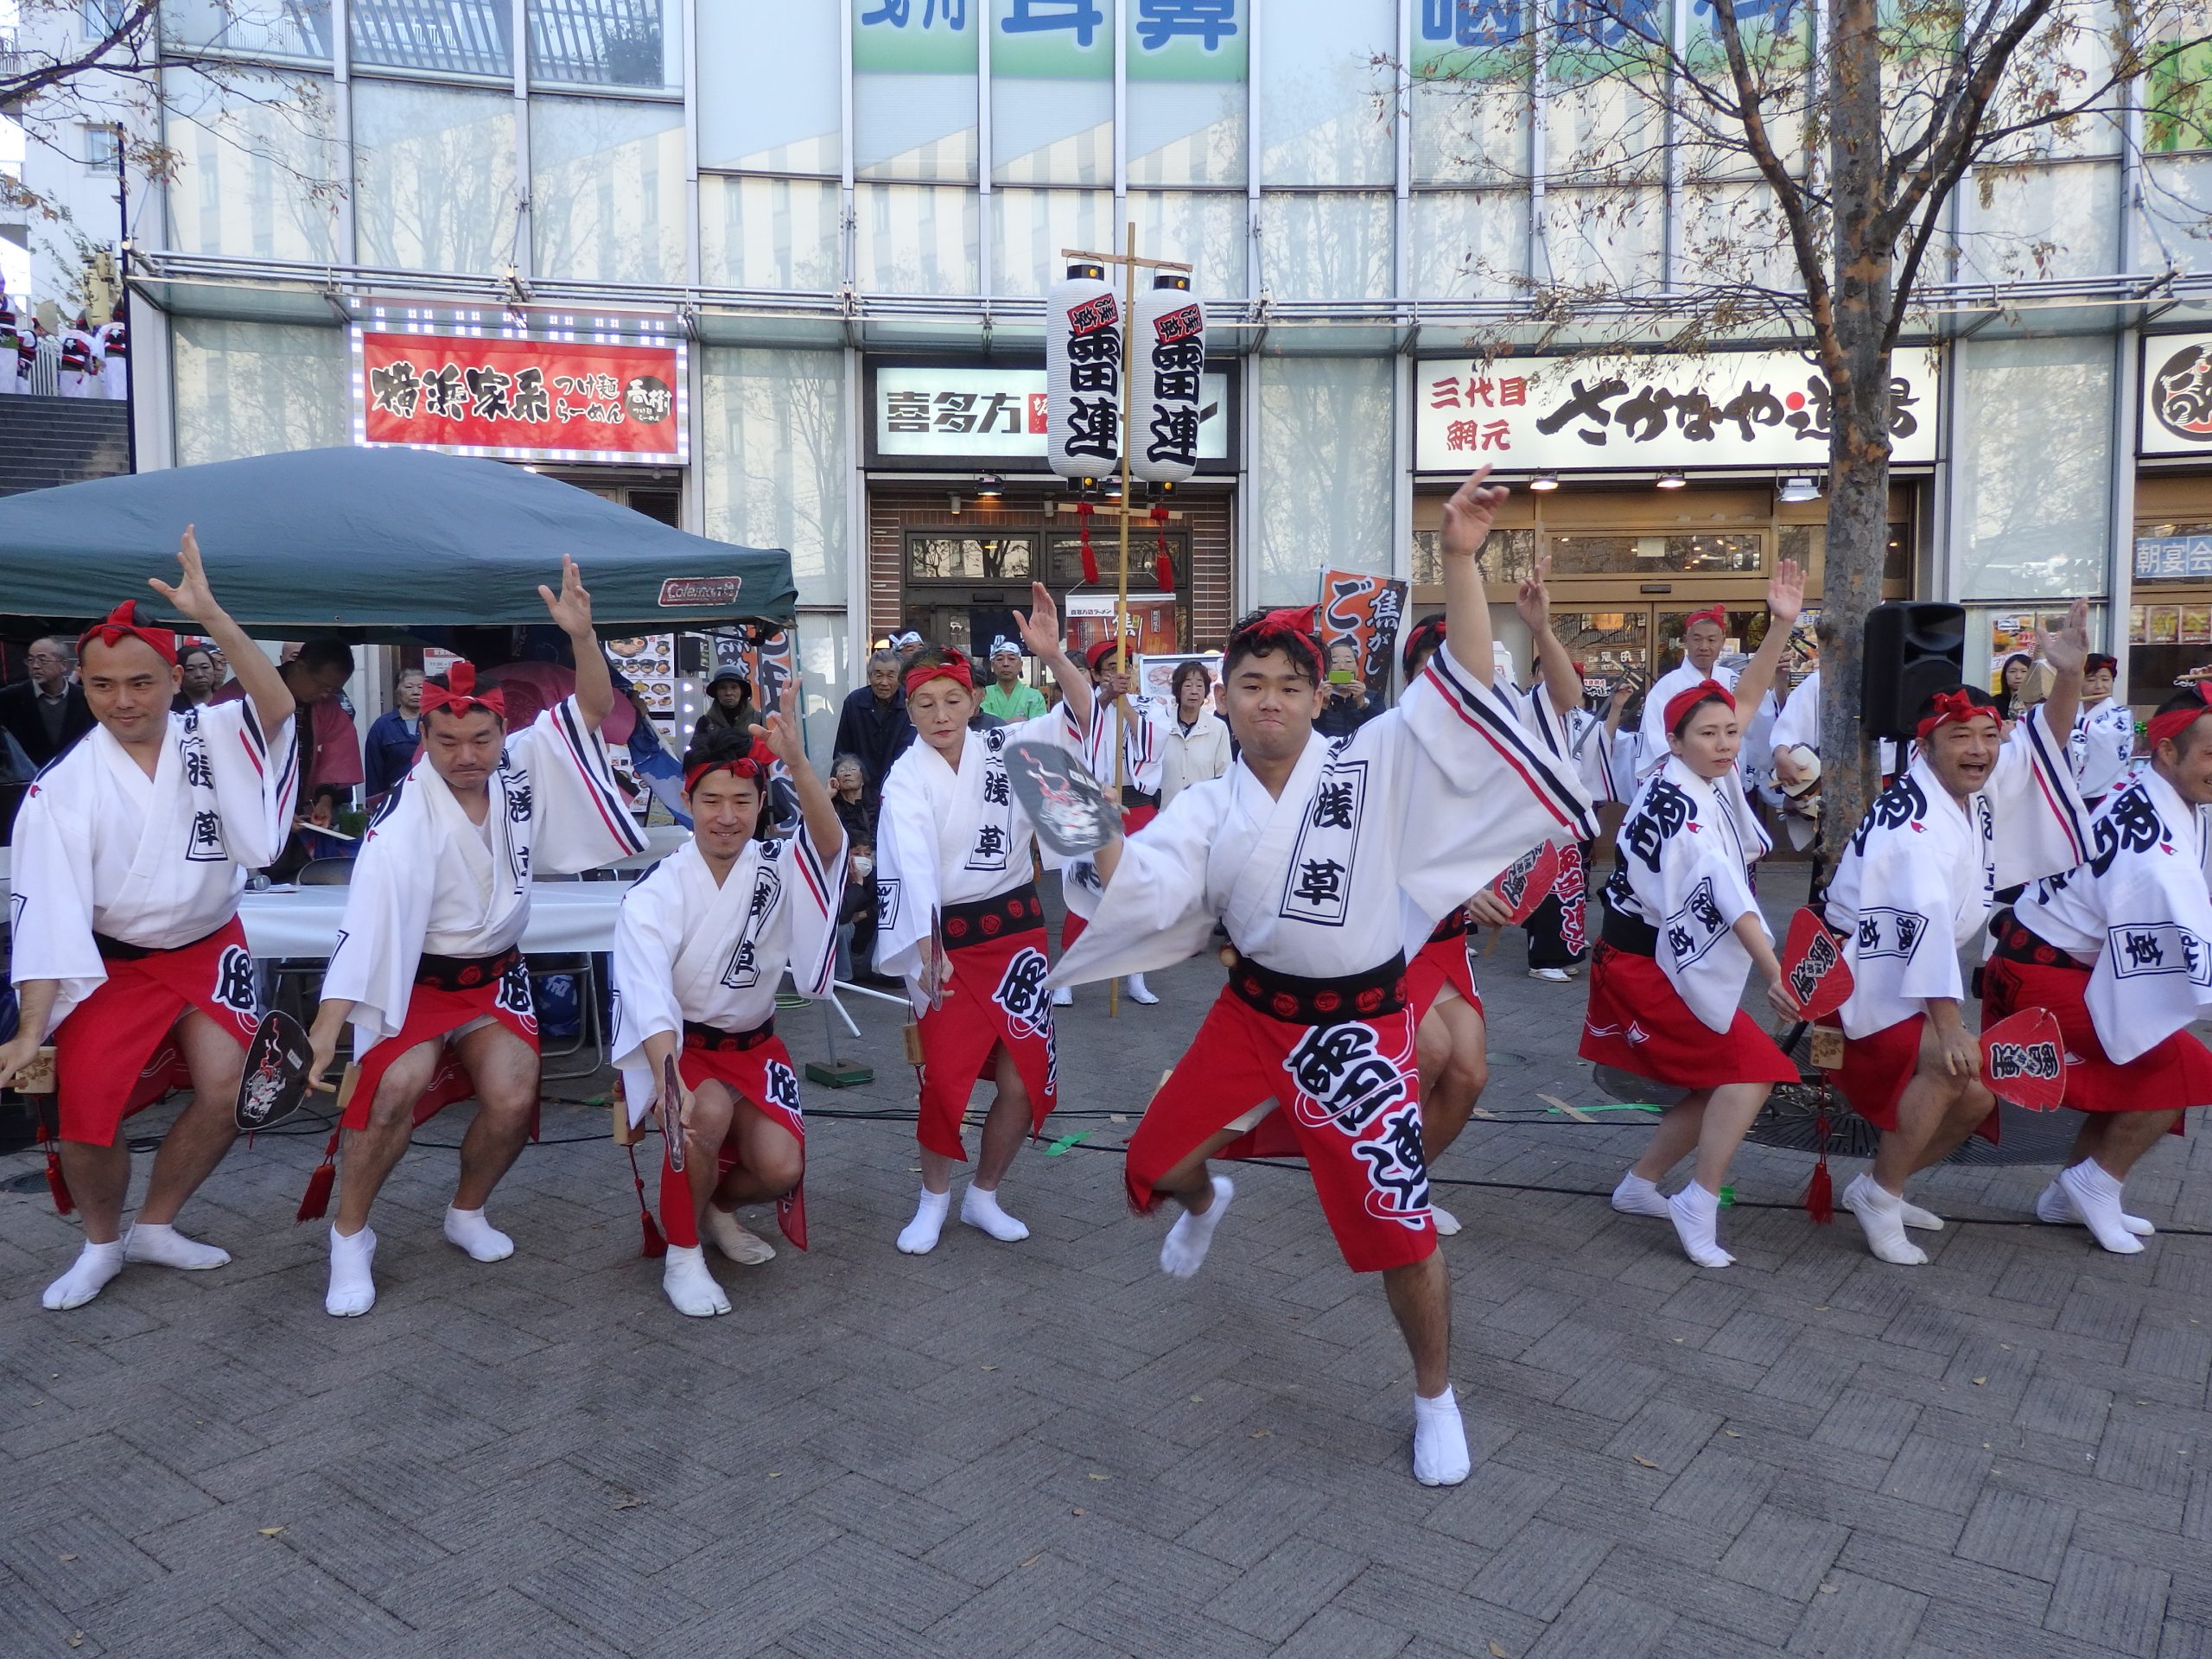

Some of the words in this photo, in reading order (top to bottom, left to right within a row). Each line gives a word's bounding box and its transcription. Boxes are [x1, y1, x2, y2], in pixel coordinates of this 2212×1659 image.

[371, 361, 550, 423] 横浜家系
[553, 373, 620, 399] つけ麺
[1430, 376, 1528, 409] 三代目
[556, 398, 625, 423] らーめん
[887, 391, 1020, 433] 喜多方
[1446, 420, 1511, 450] 網元
[1365, 589, 1401, 675] 焦がし
[975, 771, 1010, 858] 浅草
[1294, 782, 1353, 906] 浅草
